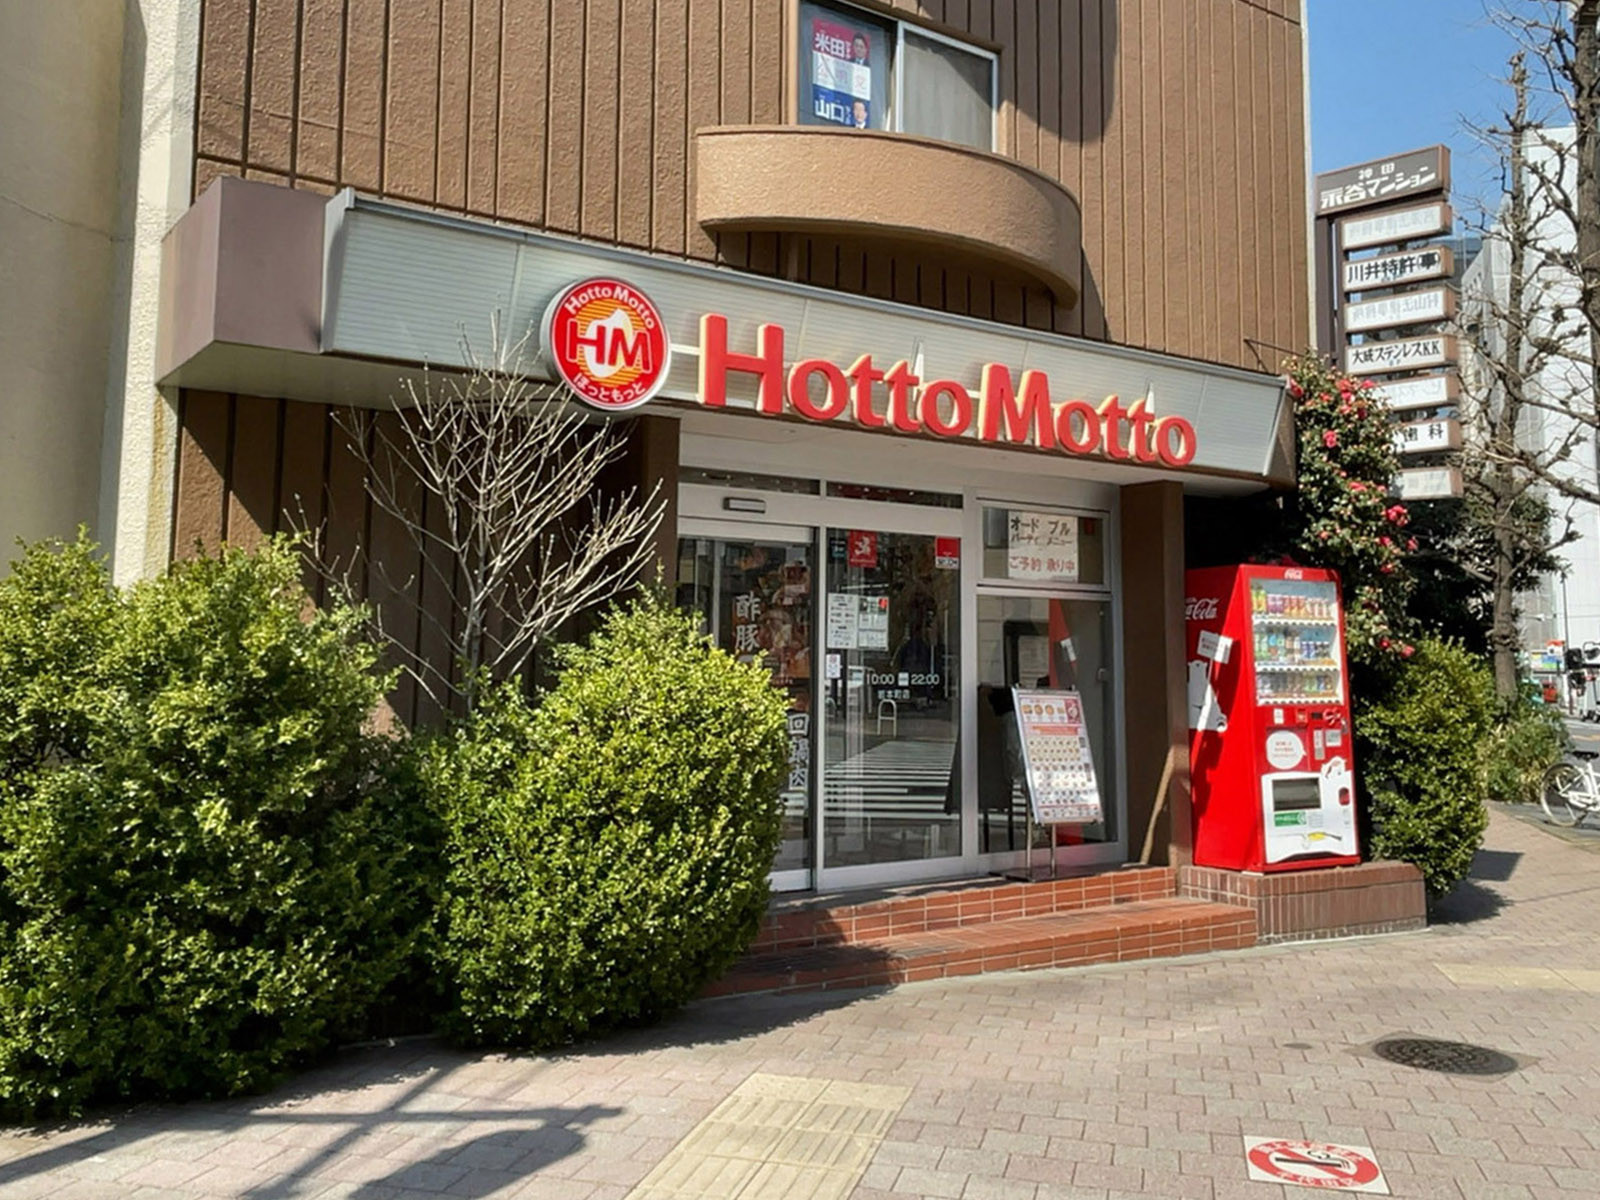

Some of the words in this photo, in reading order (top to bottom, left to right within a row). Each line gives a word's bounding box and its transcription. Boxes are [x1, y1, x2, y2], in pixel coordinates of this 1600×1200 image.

[815, 98, 845, 124] 山口
[564, 285, 612, 315] Hotto
[613, 285, 655, 329] Motto
[566, 318, 653, 375] HM
[573, 373, 645, 402] ほっともっと
[698, 313, 973, 437] Hotto
[978, 362, 1197, 467] Motto
[735, 590, 761, 652] 酢豚
[867, 673, 895, 685] 10:00
[911, 673, 940, 685] 22:00
